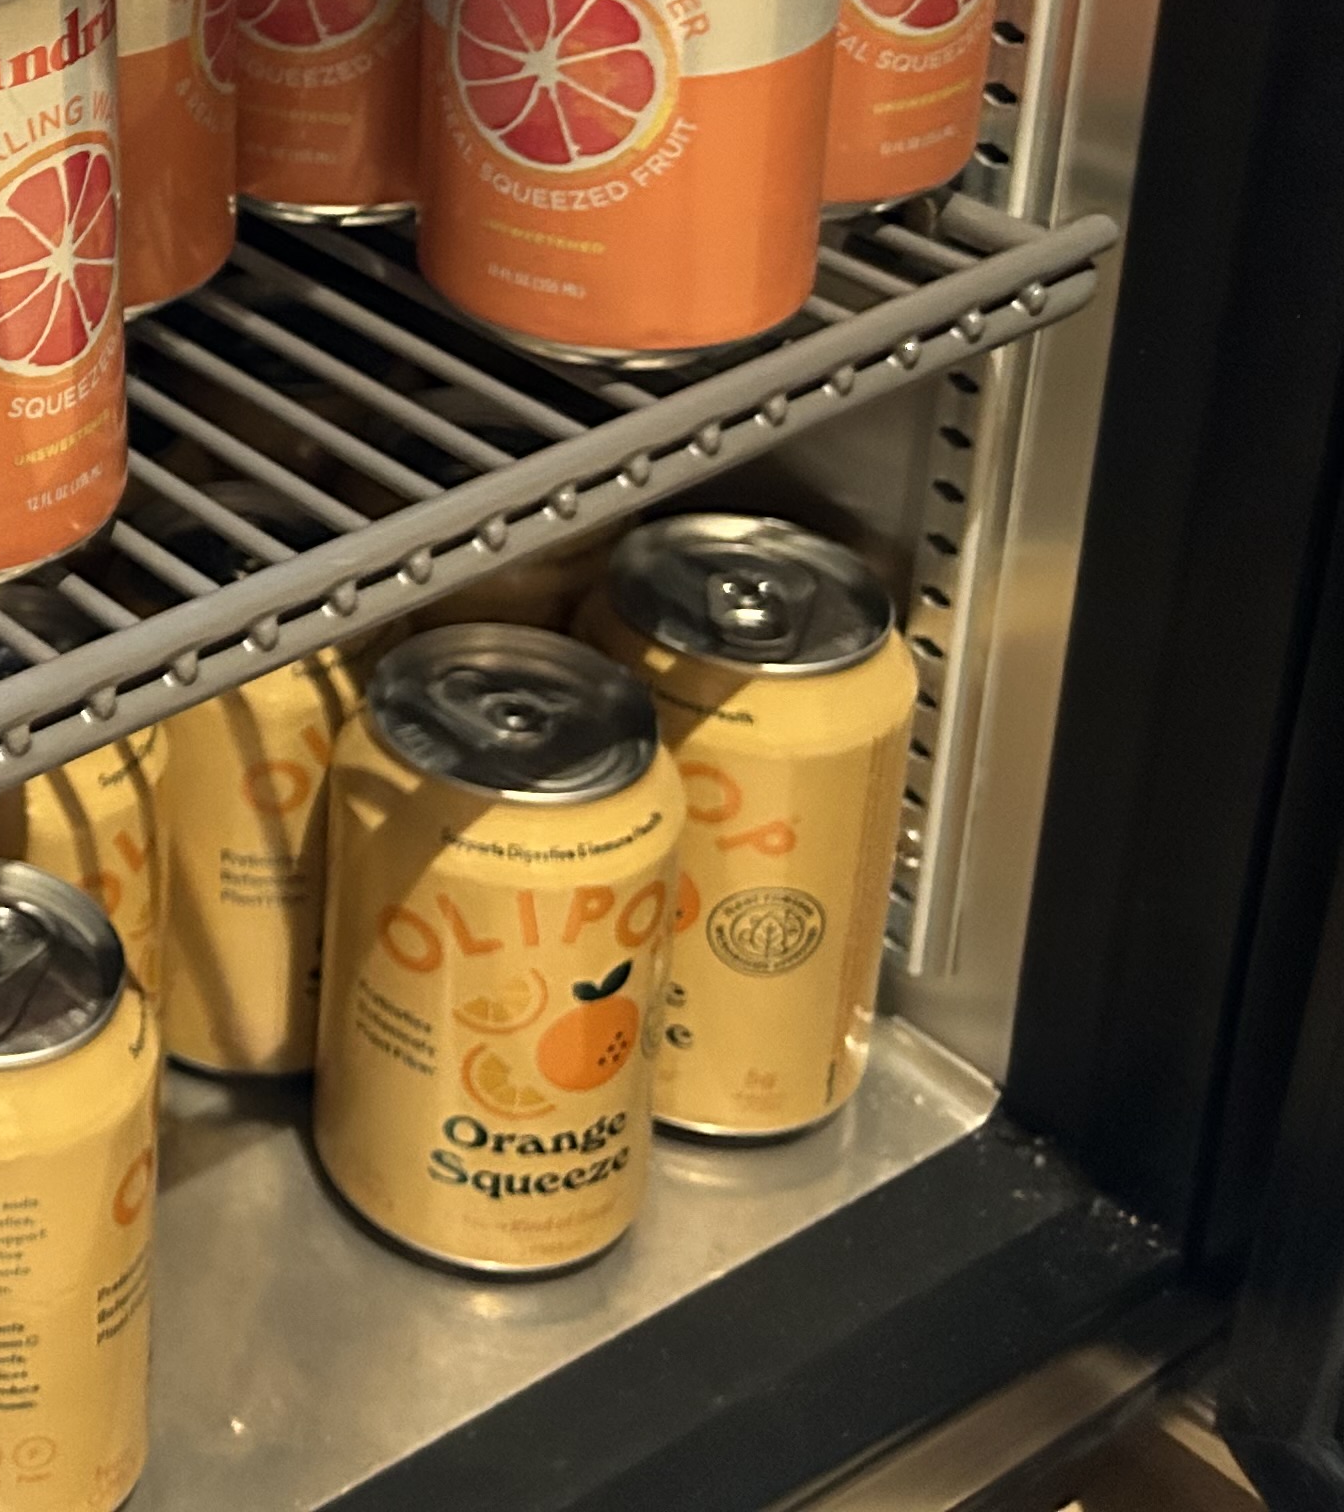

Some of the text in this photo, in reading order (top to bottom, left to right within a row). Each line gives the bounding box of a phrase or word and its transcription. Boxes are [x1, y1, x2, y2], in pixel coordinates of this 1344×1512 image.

[478, 160, 630, 213] SQUEEZED
[631, 117, 700, 188] FRUIT
[376, 879, 667, 974] OLIPO
[425, 1143, 632, 1201] Squeeze
[440, 1109, 629, 1159] Orange
